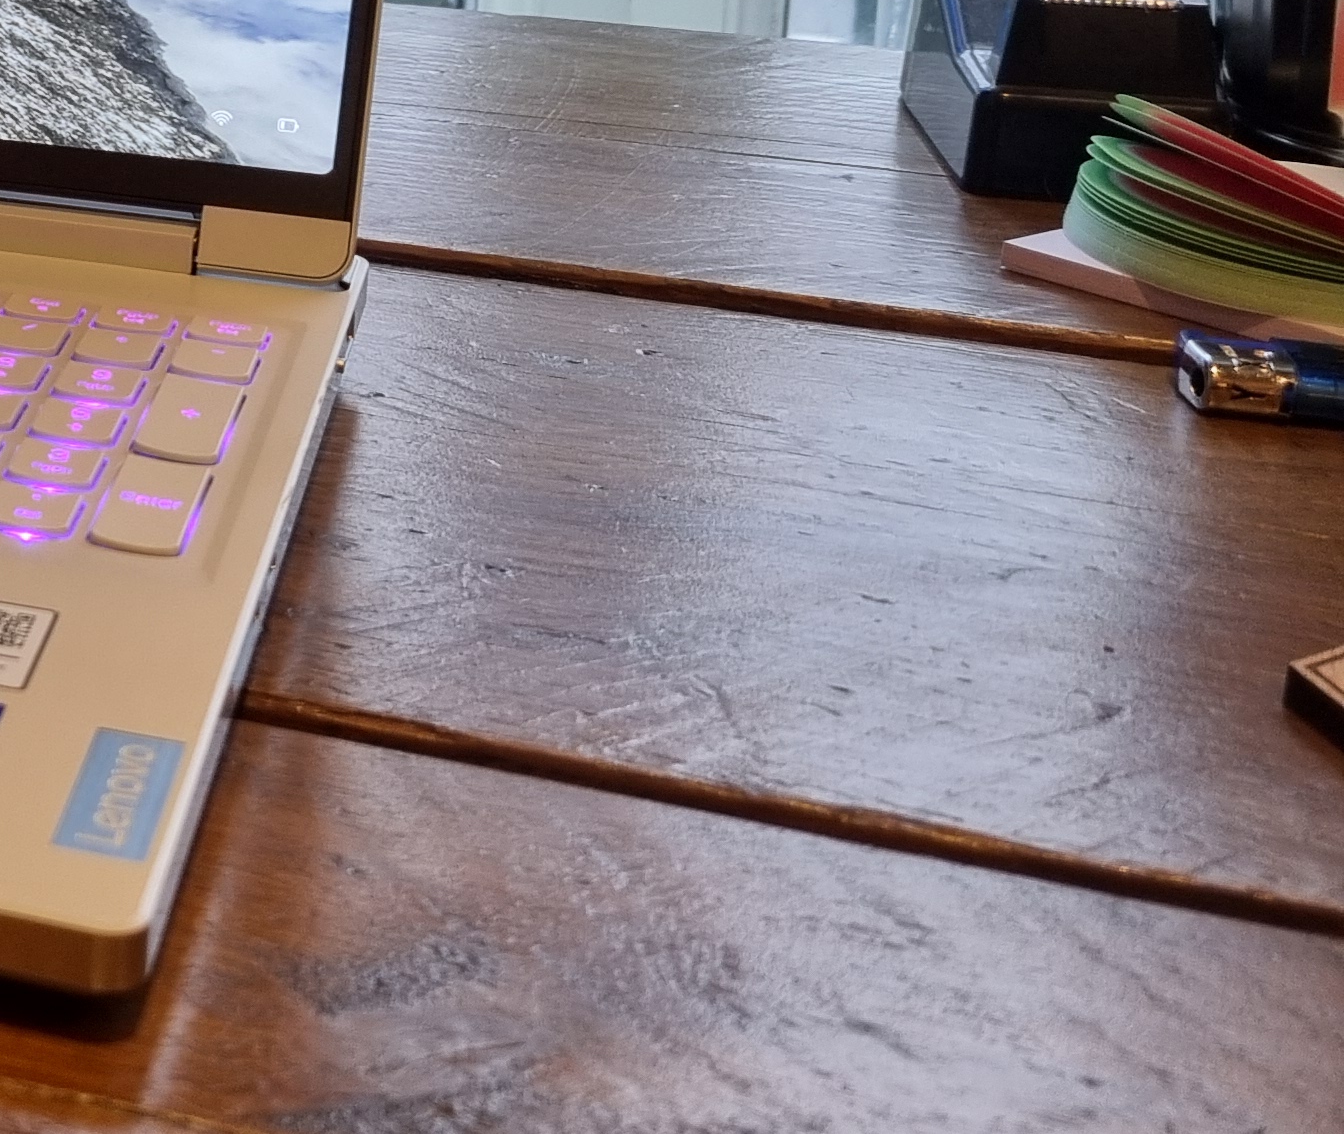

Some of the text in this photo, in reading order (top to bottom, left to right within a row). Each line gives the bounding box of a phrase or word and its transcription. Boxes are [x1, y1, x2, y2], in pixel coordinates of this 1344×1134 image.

[91, 368, 113, 382] 9
[119, 489, 184, 511] Enter
[73, 743, 156, 848] Lenovo
